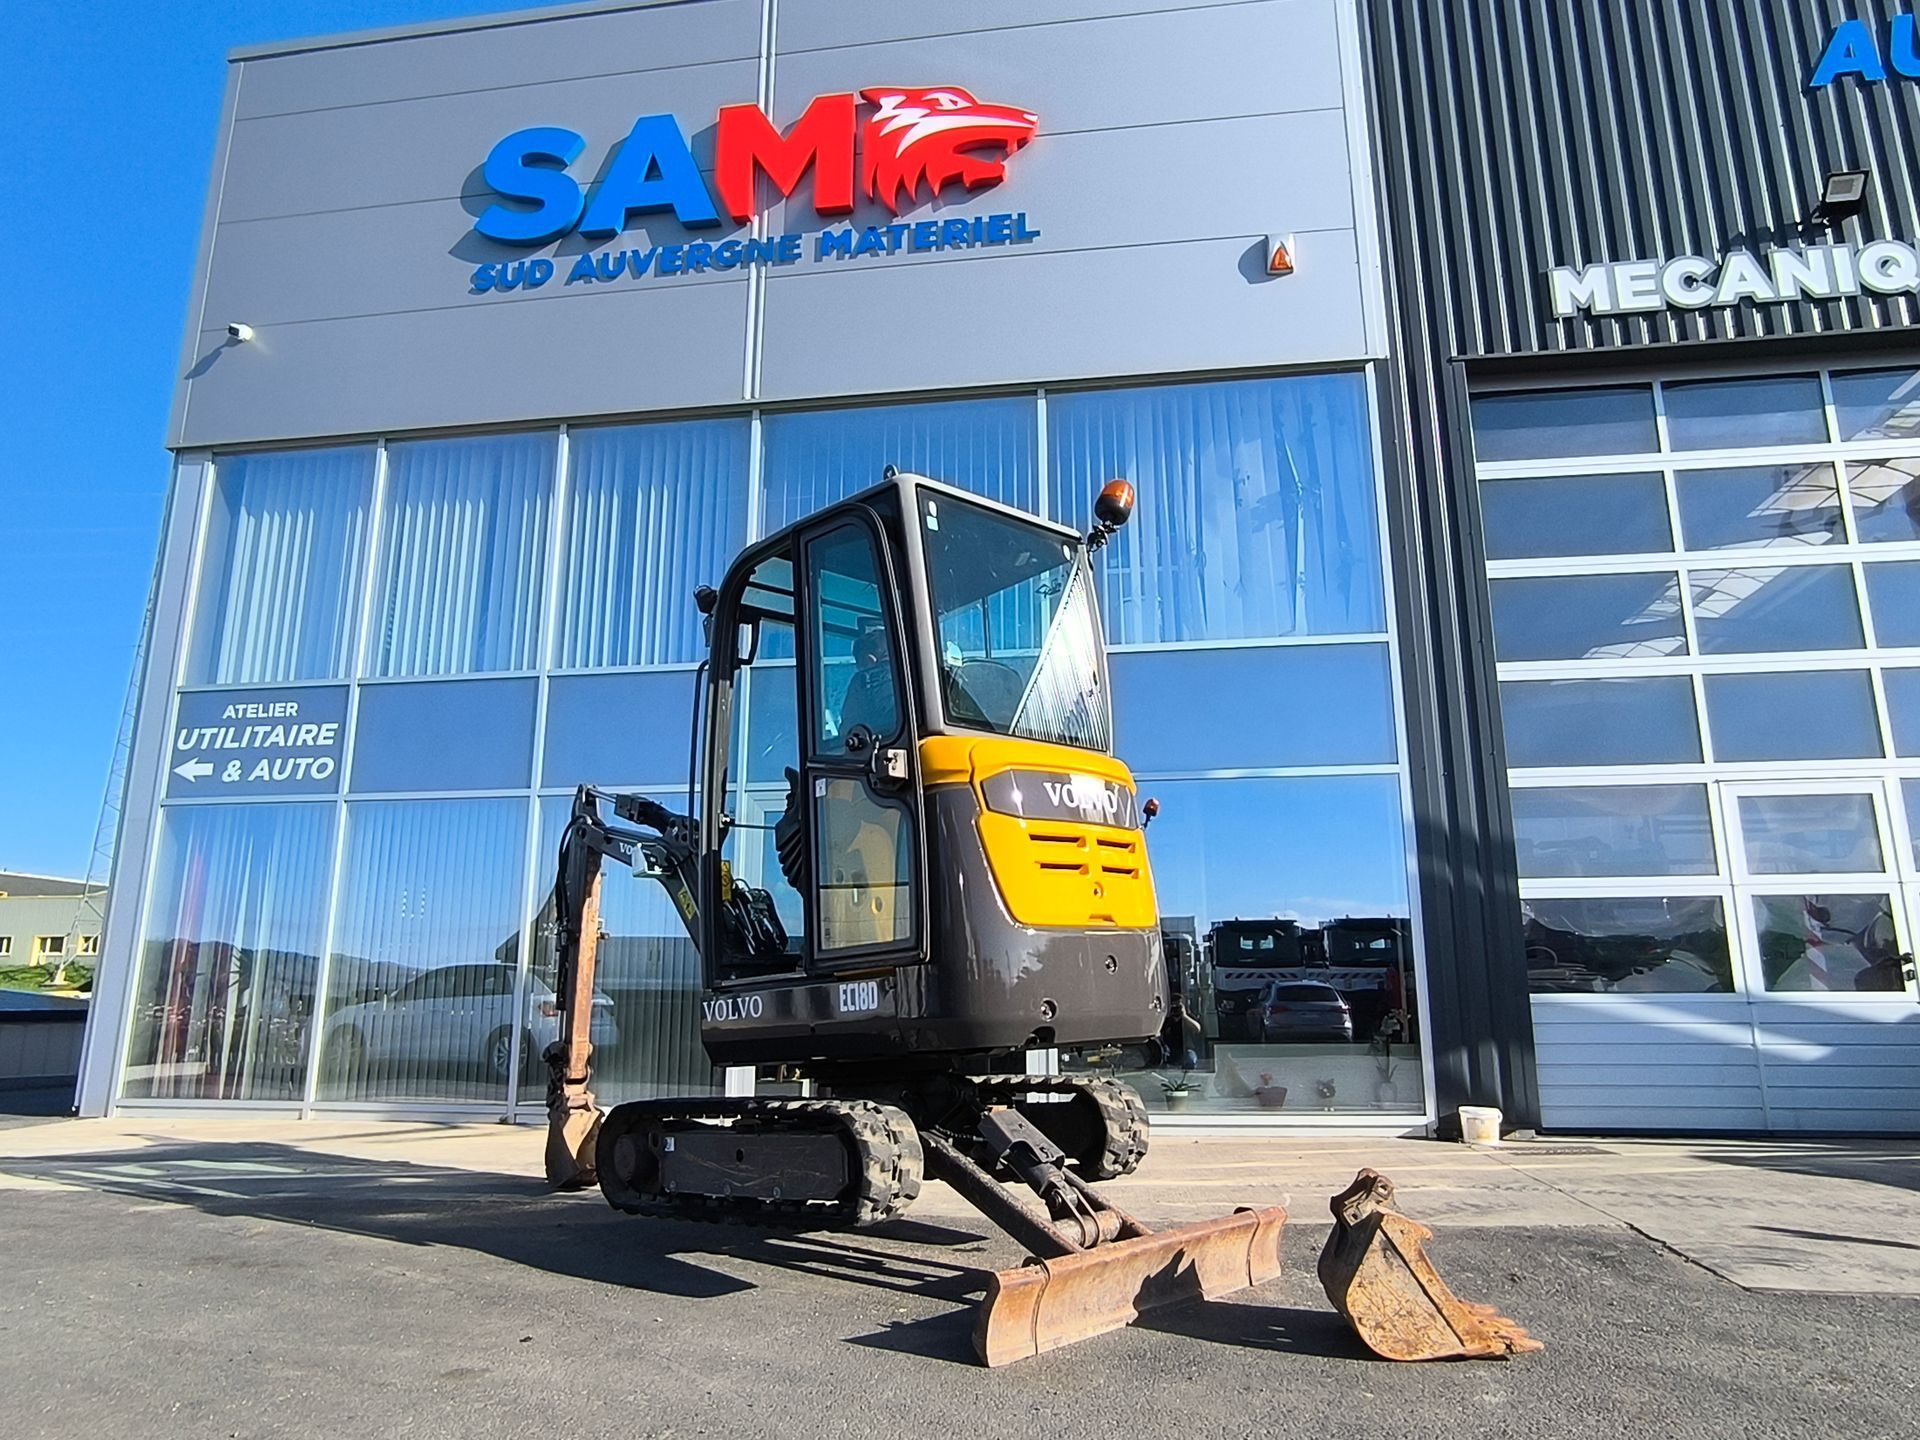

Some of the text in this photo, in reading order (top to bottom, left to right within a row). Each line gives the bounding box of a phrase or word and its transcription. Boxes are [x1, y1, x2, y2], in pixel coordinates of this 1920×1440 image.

[473, 92, 857, 247] SAM
[473, 212, 1041, 291] SUD AUVERGNE MATERIEL
[1551, 241, 1920, 316] MECANIQ
[222, 702, 298, 719] ATELIER
[177, 722, 339, 750] UTILITAIRE
[221, 756, 335, 783] & AUTO
[702, 995, 763, 1022] VOLVO
[838, 981, 878, 1012] EC18D
